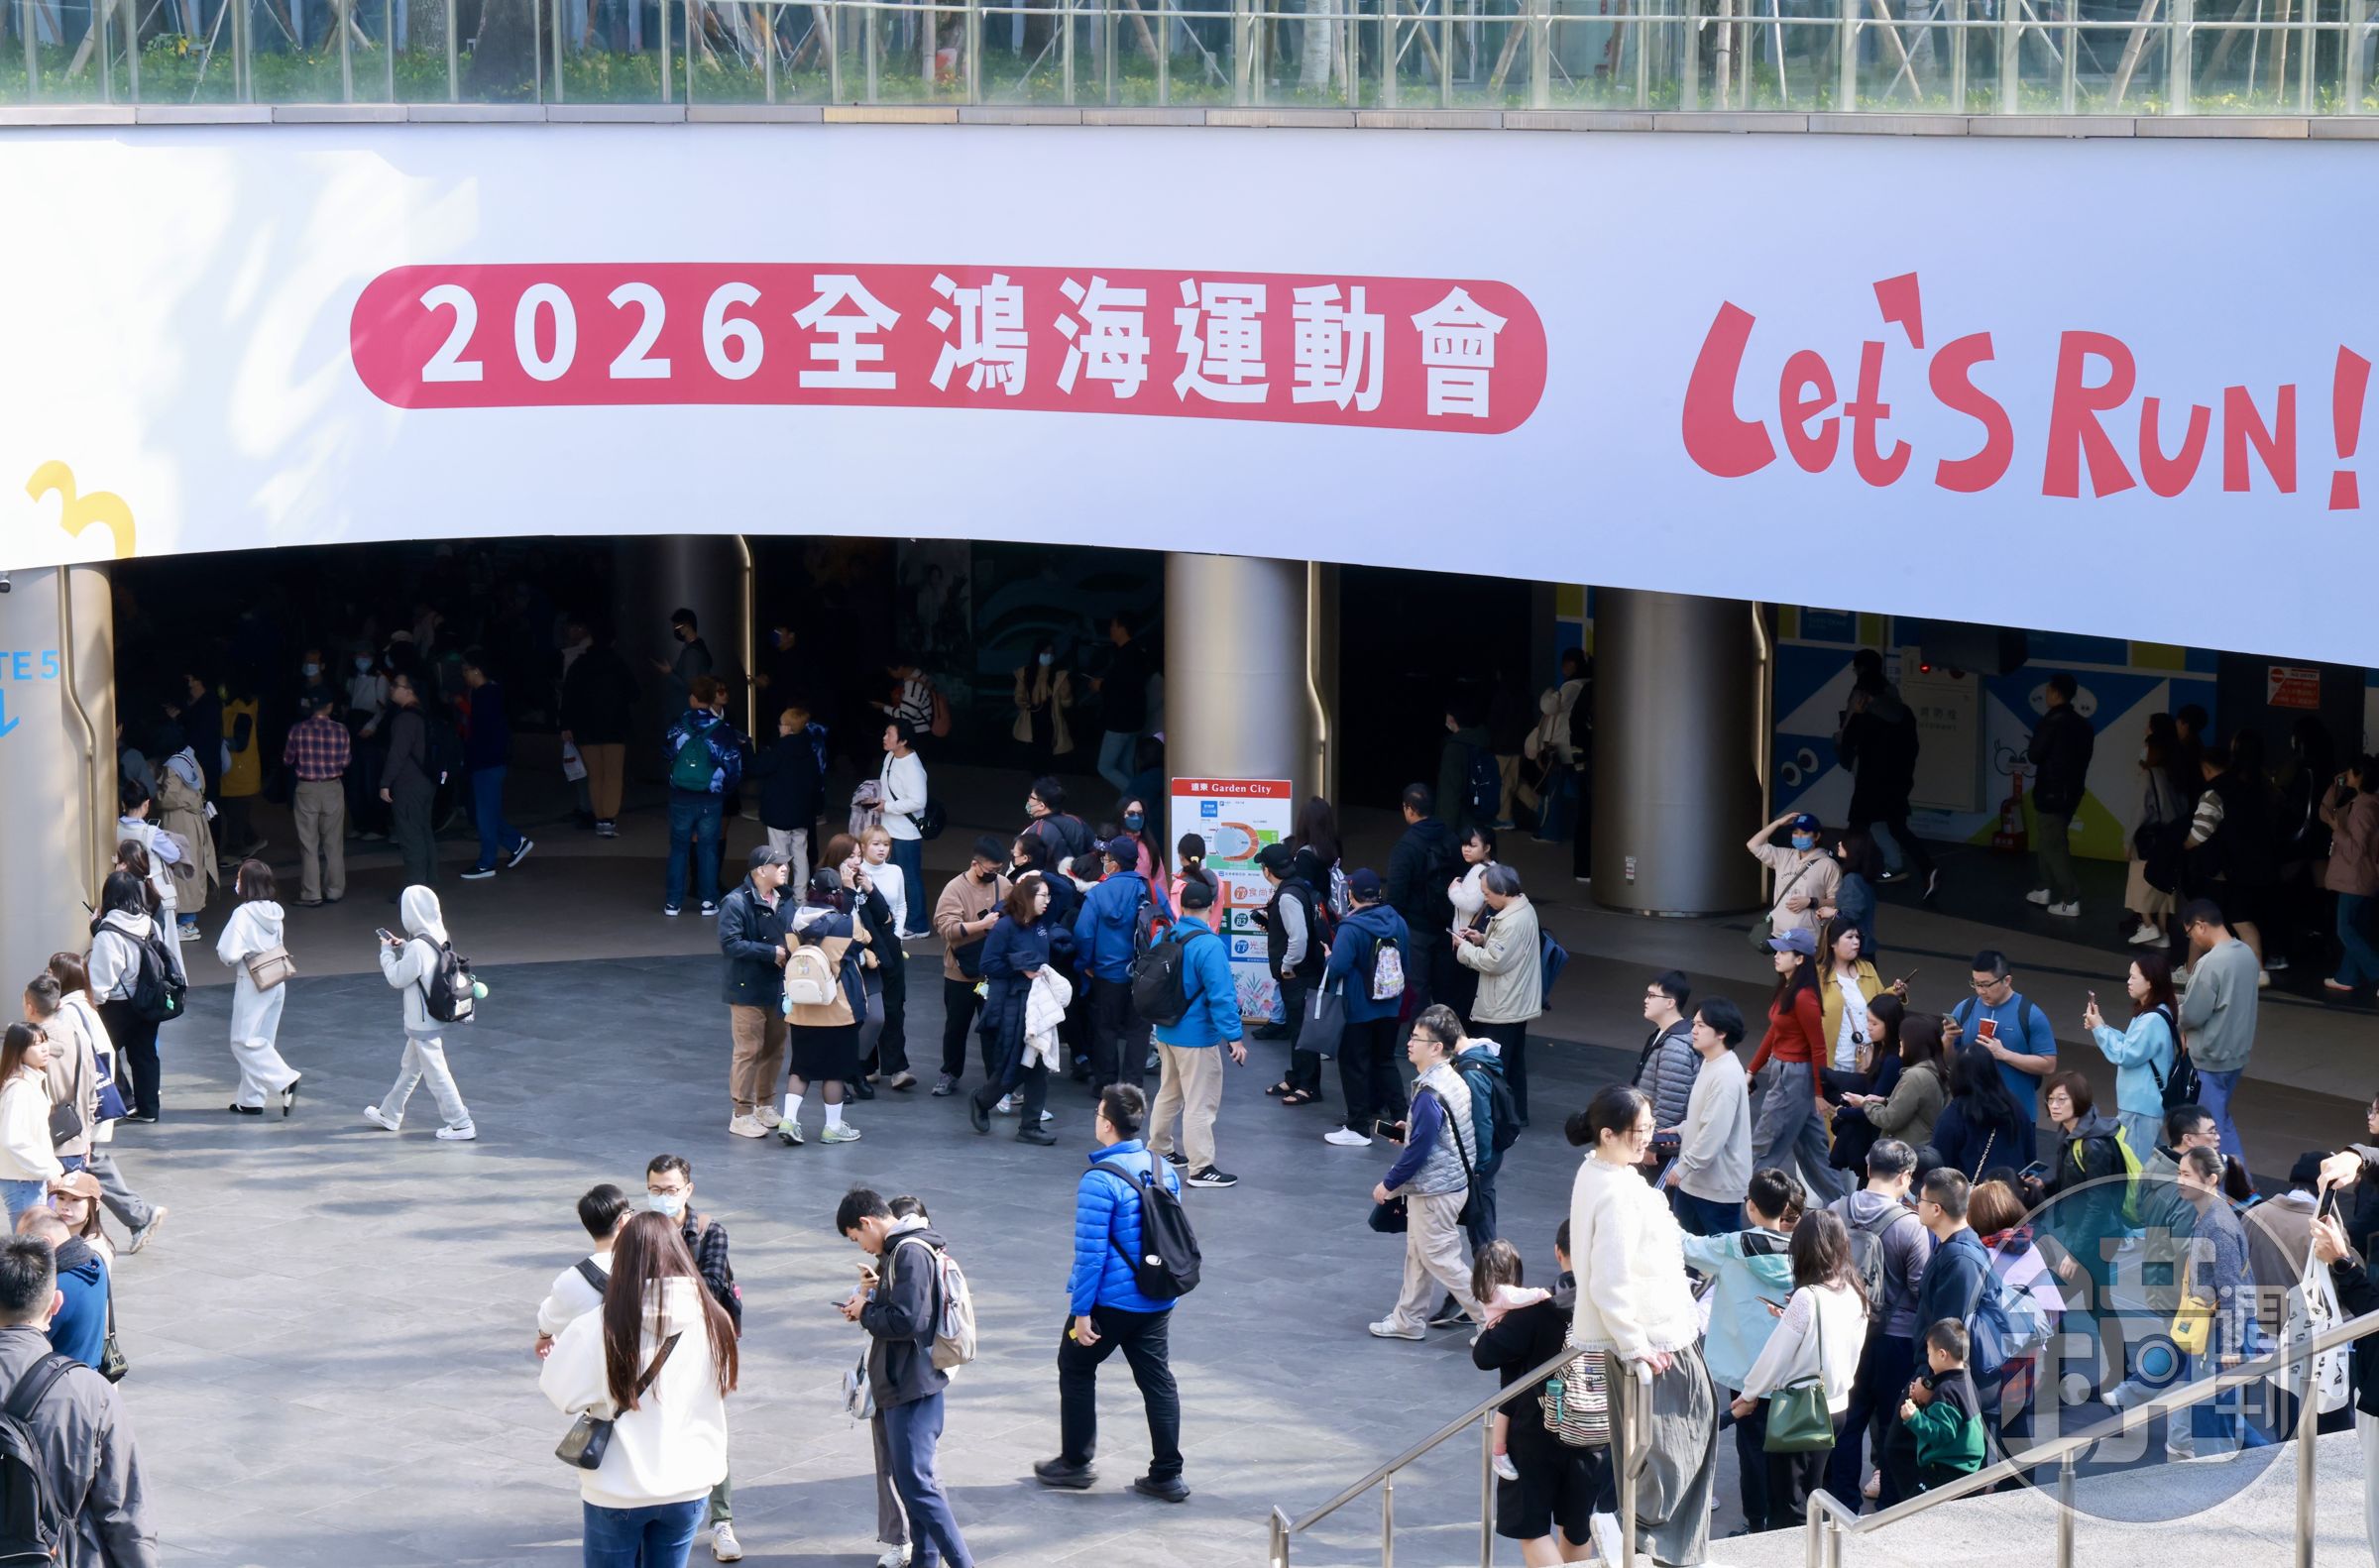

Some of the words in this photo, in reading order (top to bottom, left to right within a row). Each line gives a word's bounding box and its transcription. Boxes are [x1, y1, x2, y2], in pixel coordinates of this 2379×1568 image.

[419, 273, 1509, 419] 2026全鴻海運動會
[41, 649, 59, 680] 5
[1211, 783, 1247, 793] Garden
[1250, 784, 1272, 795] City
